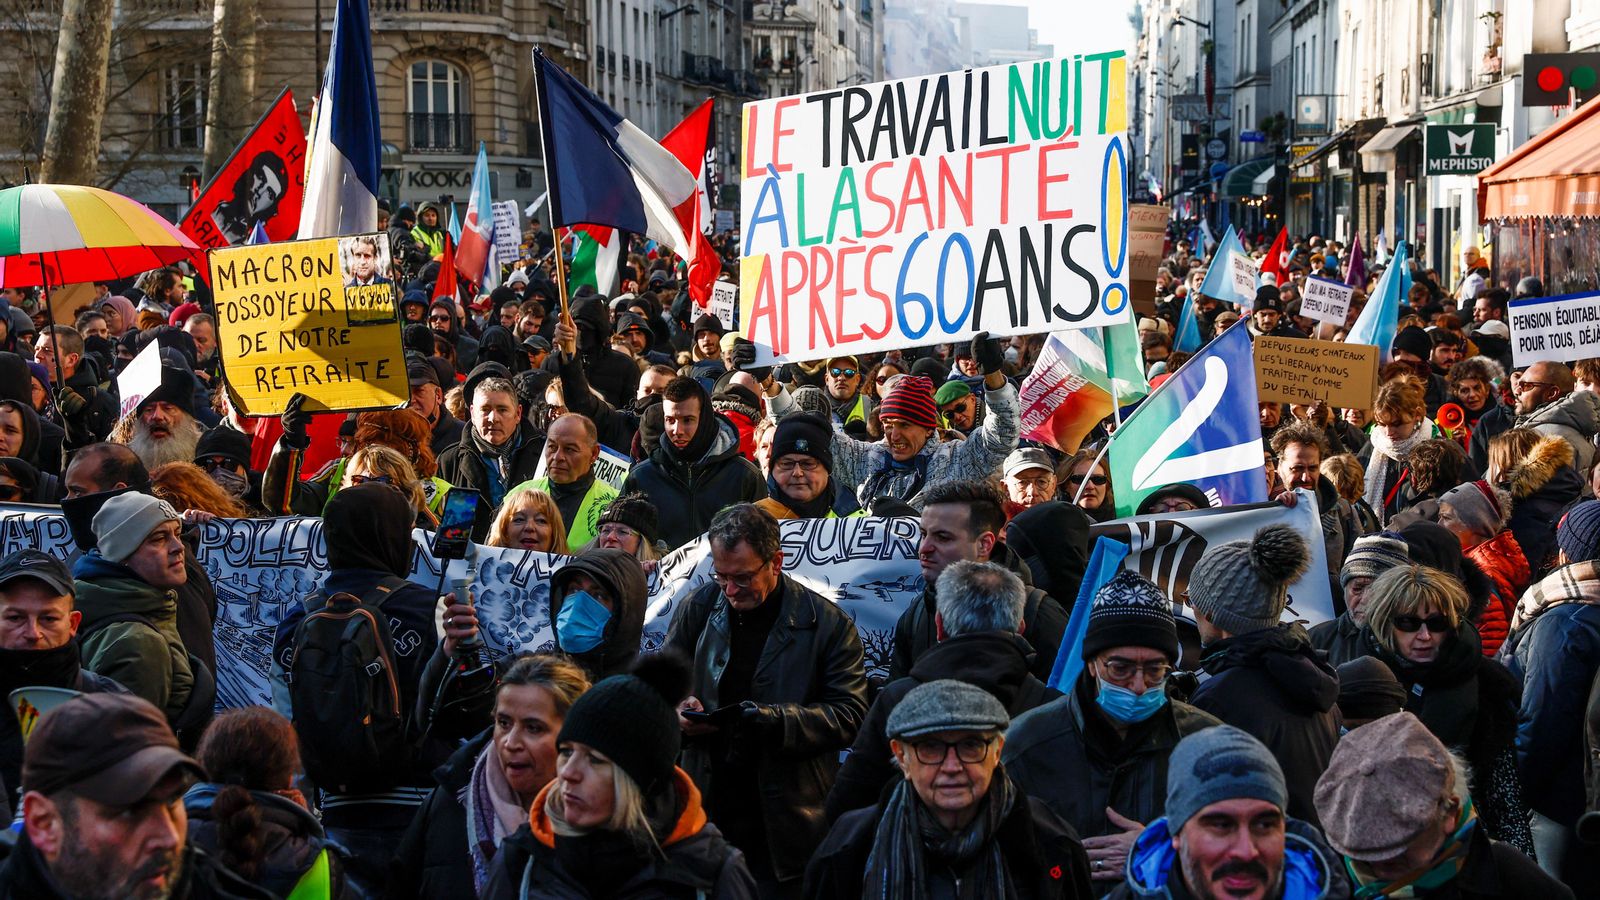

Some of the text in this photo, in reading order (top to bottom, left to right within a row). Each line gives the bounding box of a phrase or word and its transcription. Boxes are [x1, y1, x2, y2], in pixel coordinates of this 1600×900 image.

[747, 98, 801, 179] LE
[806, 69, 1008, 168] TRAVAIL
[1008, 50, 1126, 144] NUIT
[1429, 157, 1493, 171] MEPHISTO
[744, 162, 789, 257] À
[797, 166, 862, 246] LA
[862, 125, 1079, 239] SANTÉ
[217, 253, 334, 291] MACRON
[746, 223, 1100, 358] APRÈS 60 ANS
[1328, 287, 1348, 302] RETRAITE
[215, 287, 337, 328] FOSSOYEUR
[1513, 312, 1552, 331] PENSION
[237, 326, 352, 358] DE NOTRE
[1260, 340, 1366, 361] DEPUIS LEURS CHATEAUX
[1520, 335, 1545, 352] POUR
[1548, 332, 1576, 349] TOUS,
[254, 357, 390, 393] RETRAITE
[1260, 355, 1275, 364] LES
[1324, 366, 1349, 378] NOUS
[1261, 367, 1342, 390] TRAITENT COMME
[1262, 381, 1279, 391] DU
[198, 517, 333, 569] POLLU
[780, 517, 921, 571] GUER
